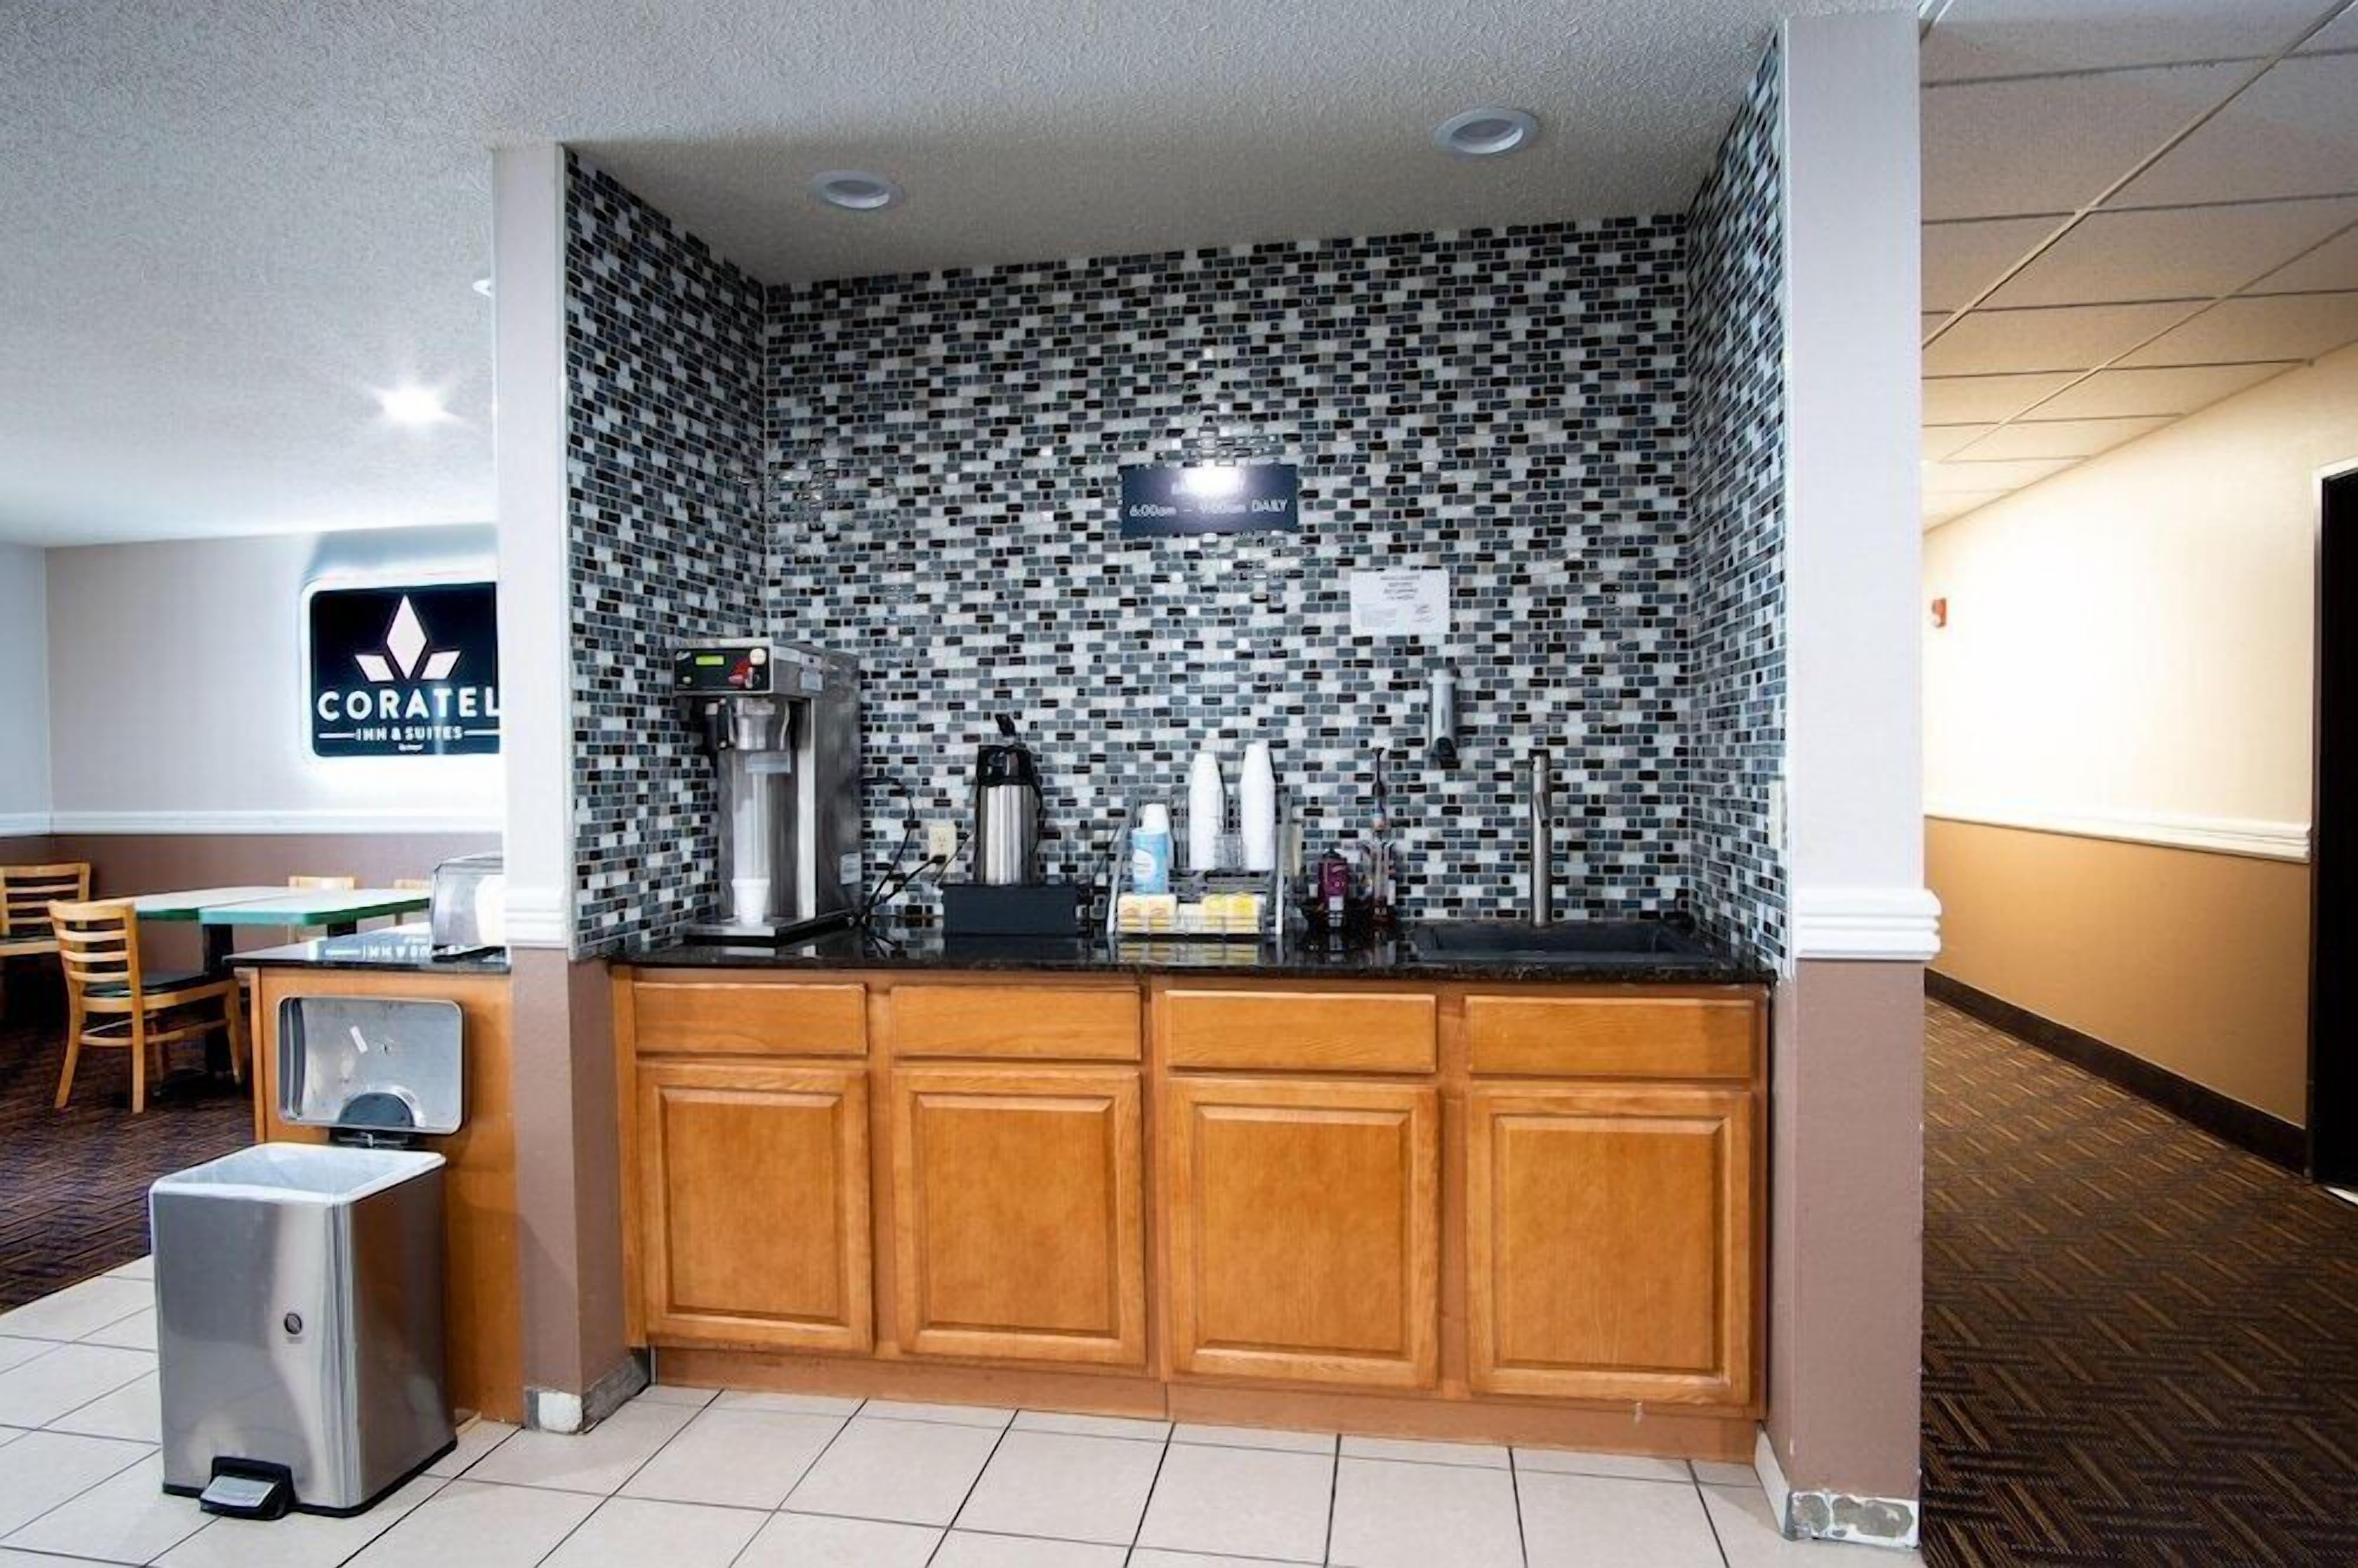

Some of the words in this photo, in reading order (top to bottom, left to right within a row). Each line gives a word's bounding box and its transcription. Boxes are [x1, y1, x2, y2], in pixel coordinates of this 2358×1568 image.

[1252, 498, 1288, 512] DAILY
[317, 686, 499, 721] CORATEL
[355, 727, 387, 741] INN
[405, 726, 463, 741] SUITES
